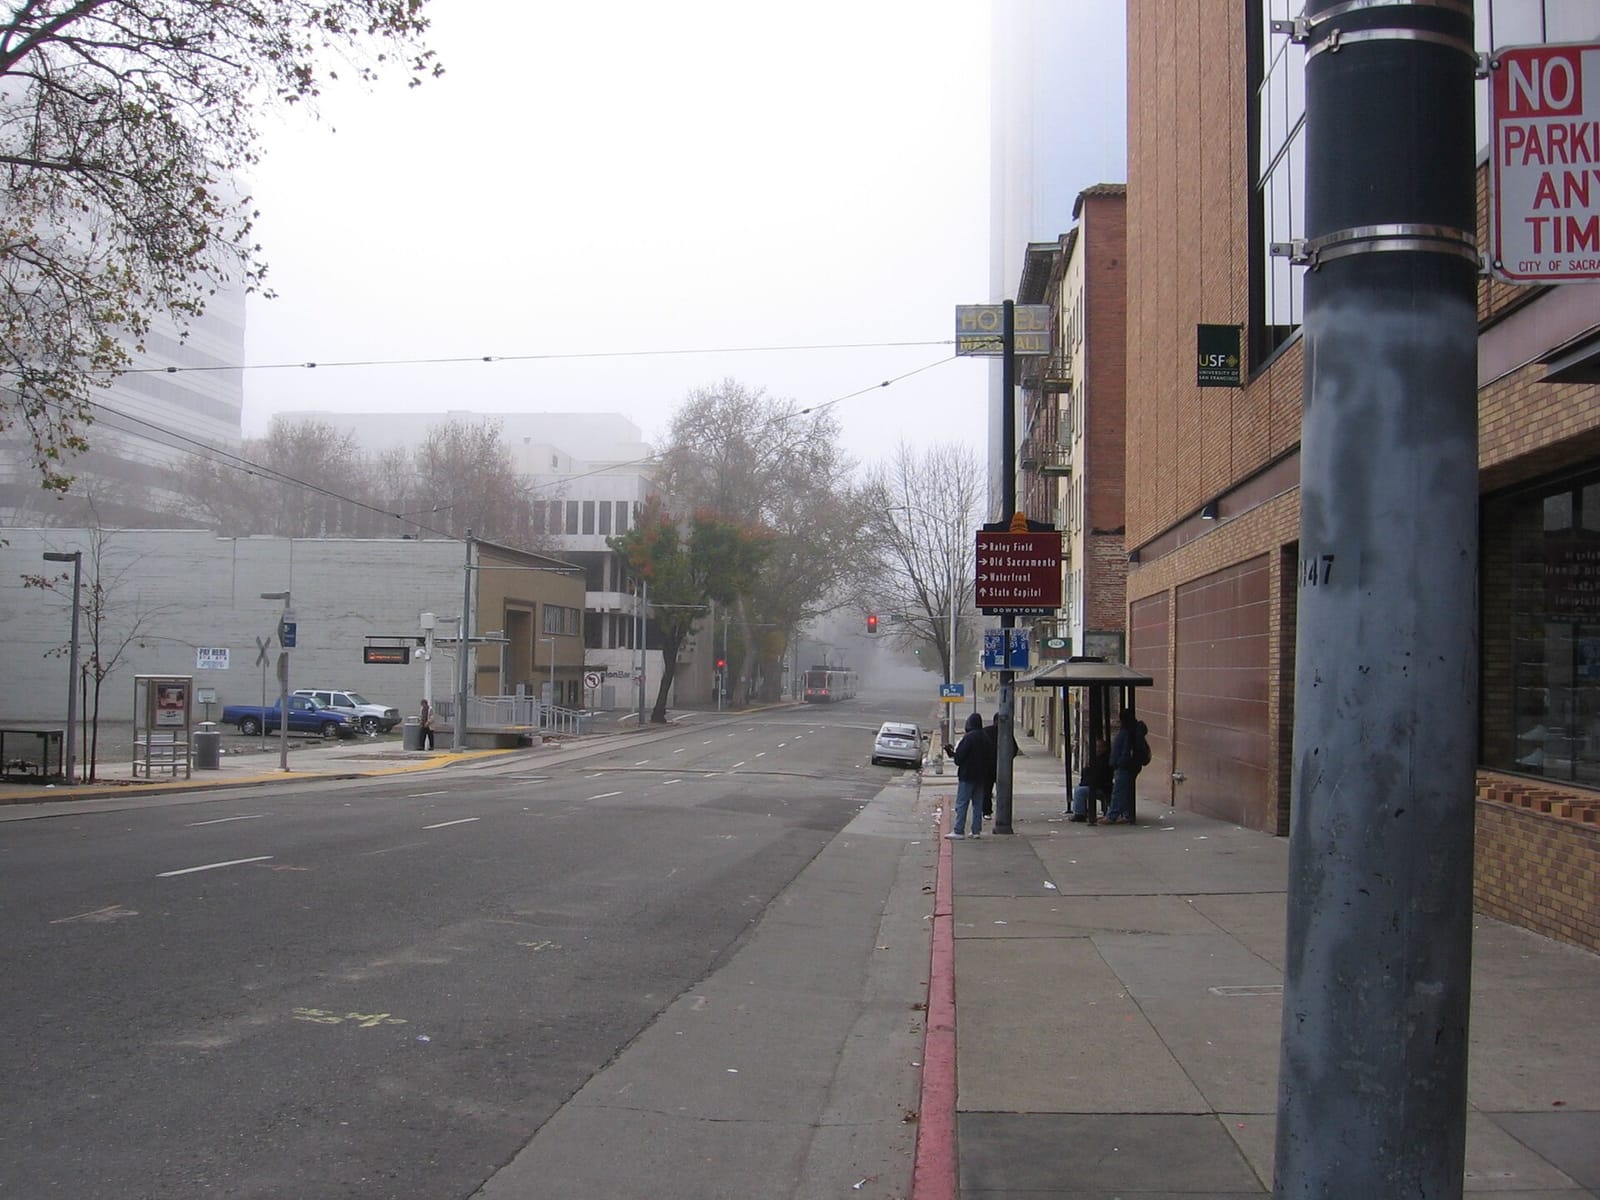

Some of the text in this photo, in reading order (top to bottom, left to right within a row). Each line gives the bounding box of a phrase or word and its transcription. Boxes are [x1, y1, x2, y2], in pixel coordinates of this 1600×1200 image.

[1508, 56, 1575, 112] NO
[1504, 121, 1600, 167] PARKI
[1532, 170, 1600, 210] AN
[1518, 260, 1542, 273] CITY
[1548, 260, 1562, 272] OF
[961, 308, 1047, 331] HOEL
[960, 335, 1043, 350] MARSALL
[1199, 354, 1226, 368] USF
[989, 542, 1033, 552] Raley Field
[989, 557, 1056, 567] Old Sacramento
[989, 572, 1031, 582] Waterfront
[989, 587, 1042, 598] State Capitol
